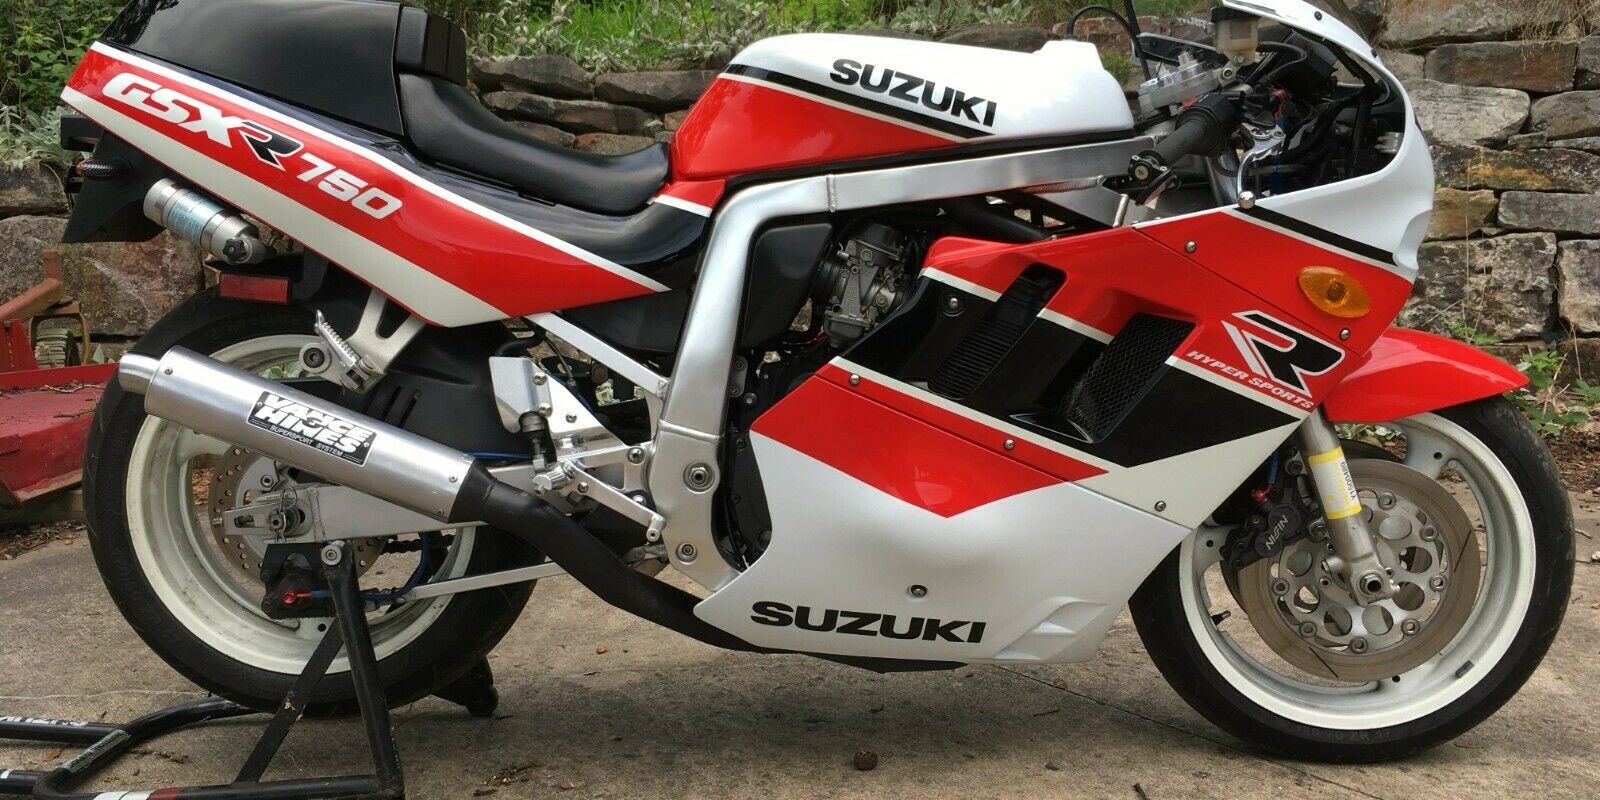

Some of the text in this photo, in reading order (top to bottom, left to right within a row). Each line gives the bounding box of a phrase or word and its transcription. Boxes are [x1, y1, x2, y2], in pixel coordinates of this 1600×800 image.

[830, 58, 997, 127] SUZUKI
[297, 152, 403, 219] 750
[1187, 350, 1314, 409] HYPER SPORTS
[254, 405, 361, 454] HINES
[264, 393, 374, 442] VANCE
[269, 425, 343, 457] SUPERSPORT SYSTEM
[1265, 514, 1289, 551] NISSIN
[750, 600, 987, 643] SUZUKI
